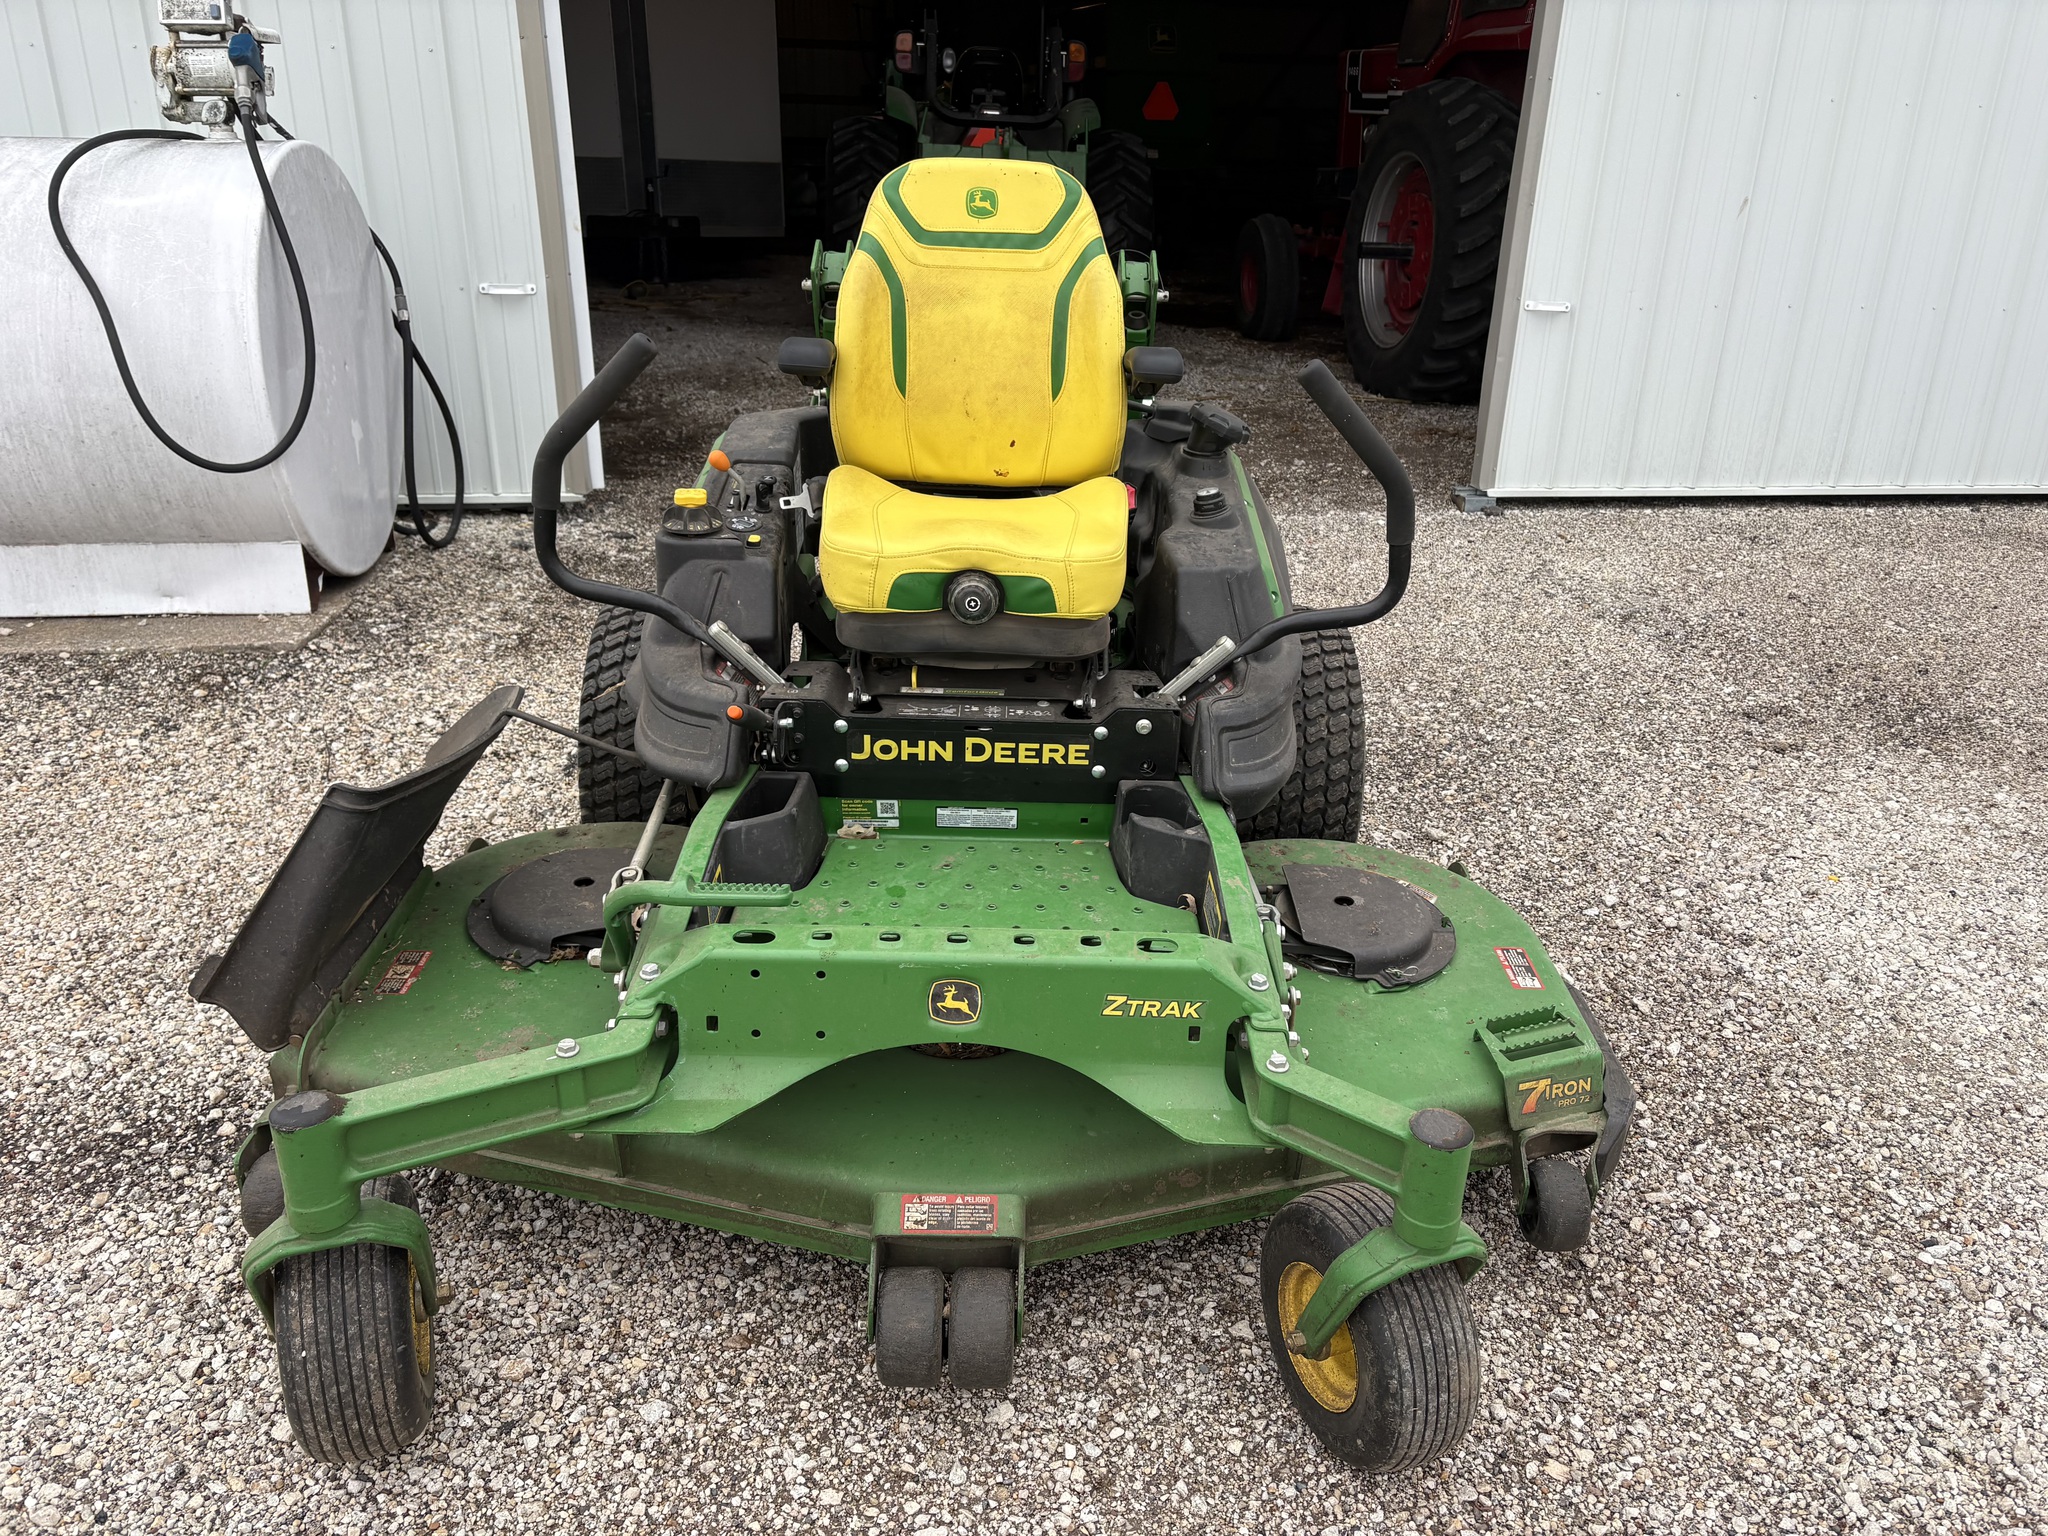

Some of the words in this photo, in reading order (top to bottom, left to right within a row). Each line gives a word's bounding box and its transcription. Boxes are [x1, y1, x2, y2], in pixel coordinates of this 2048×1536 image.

[851, 734, 953, 762] JOHN
[965, 736, 1090, 766] DEERE
[1102, 995, 1204, 1019] ZTRAK
[1558, 1098, 1576, 1108] PRO
[1579, 1095, 1591, 1103] 72
